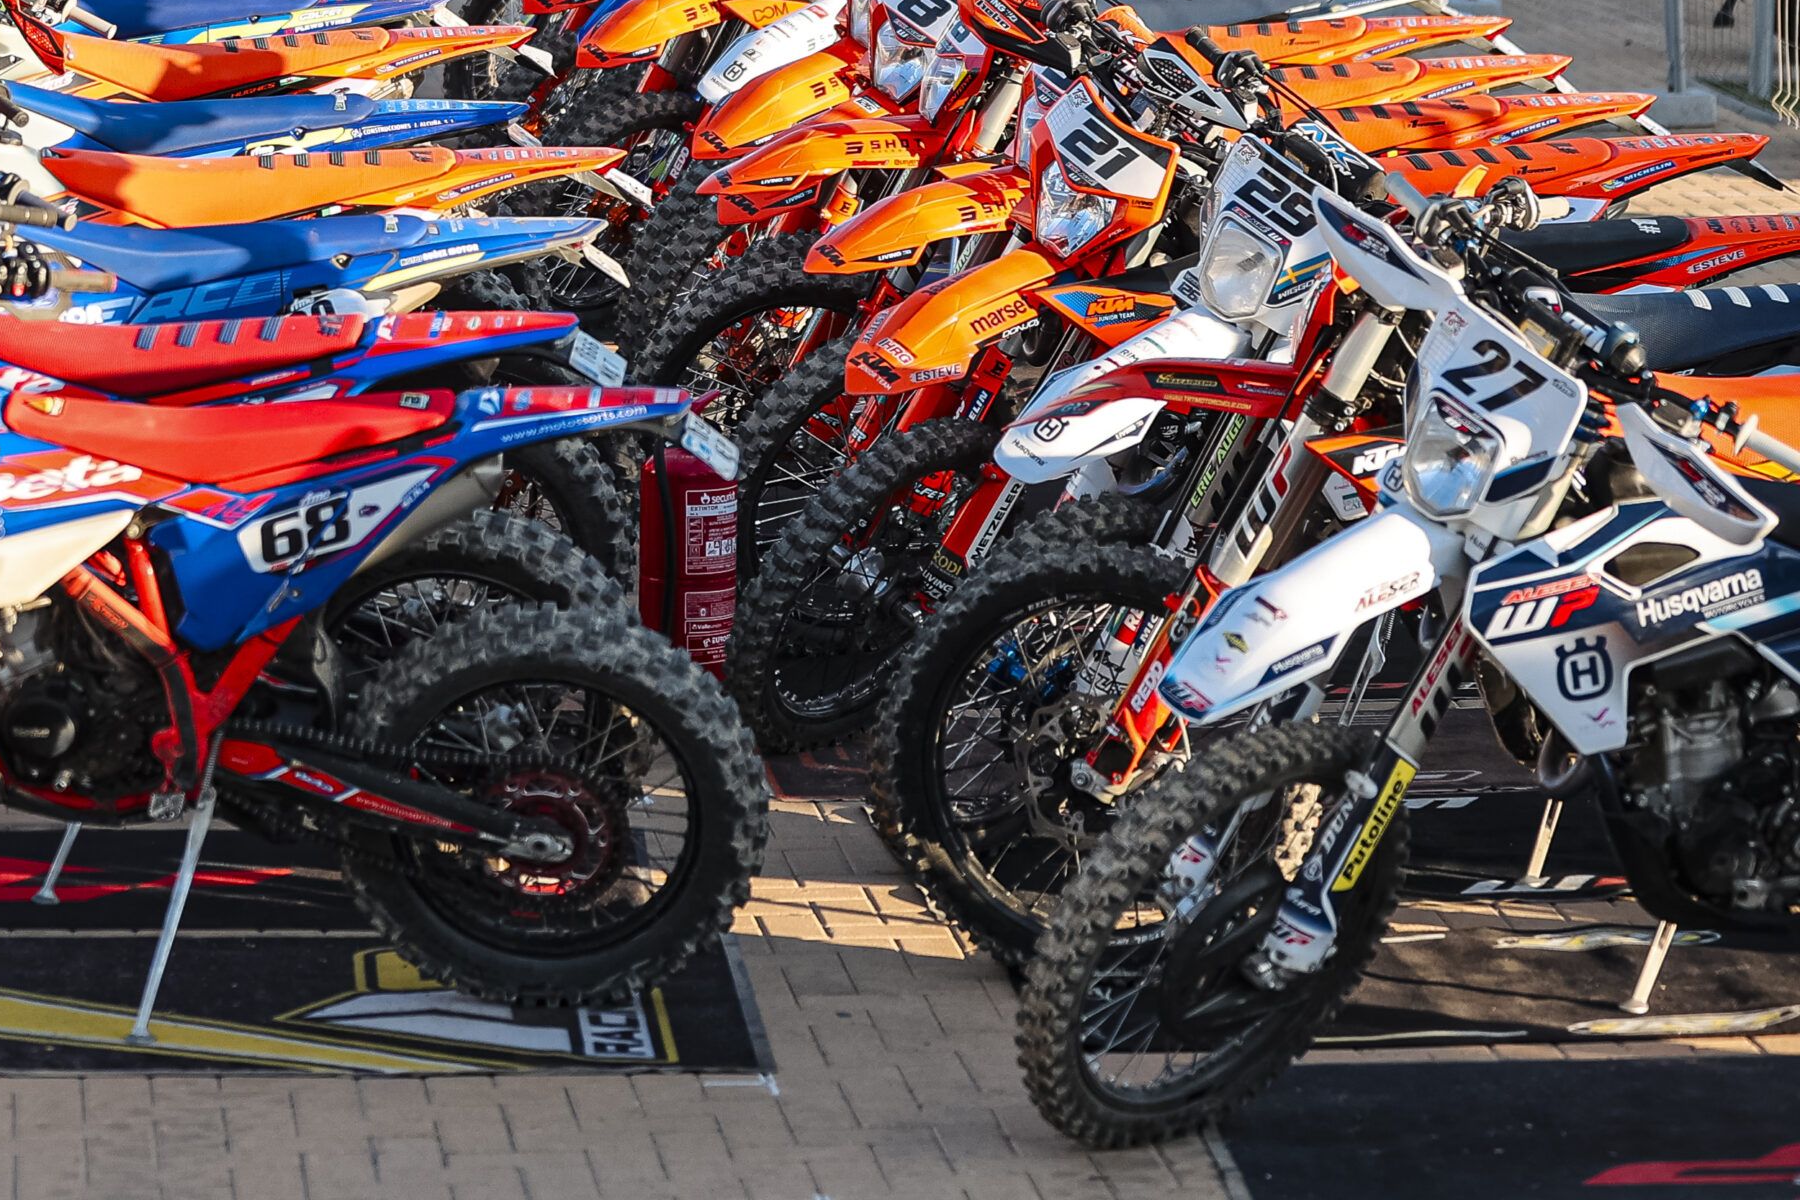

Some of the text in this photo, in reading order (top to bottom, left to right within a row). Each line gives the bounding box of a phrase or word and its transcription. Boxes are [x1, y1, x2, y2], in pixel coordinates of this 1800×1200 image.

[700, 131, 729, 154] KTM
[1509, 117, 1559, 138] MICHELIN
[1059, 117, 1140, 182] 21
[459, 172, 514, 193] MICHELIN
[1624, 160, 1674, 182] MICHELIN
[1233, 165, 1318, 238] 29
[816, 244, 846, 267] KTM
[1692, 250, 1746, 273] ESTEVE
[1087, 295, 1136, 316] KTM
[1098, 312, 1136, 323] JUNIOR TEAM
[850, 351, 902, 383] KTM
[914, 363, 962, 383] ESTEVE
[1441, 339, 1549, 414] 27
[968, 390, 989, 422] ELIN
[1012, 438, 1047, 467] Husqvarna
[1189, 466, 1217, 510] ERIC
[260, 501, 350, 564] 68
[970, 482, 1024, 563] METZELER
[1486, 583, 1600, 640] WP
[1636, 568, 1764, 628] Husqvarna
[1703, 593, 1766, 620] MOTORCYCLES
[1130, 660, 1165, 713] REDD
[1342, 778, 1406, 882] Putoline
